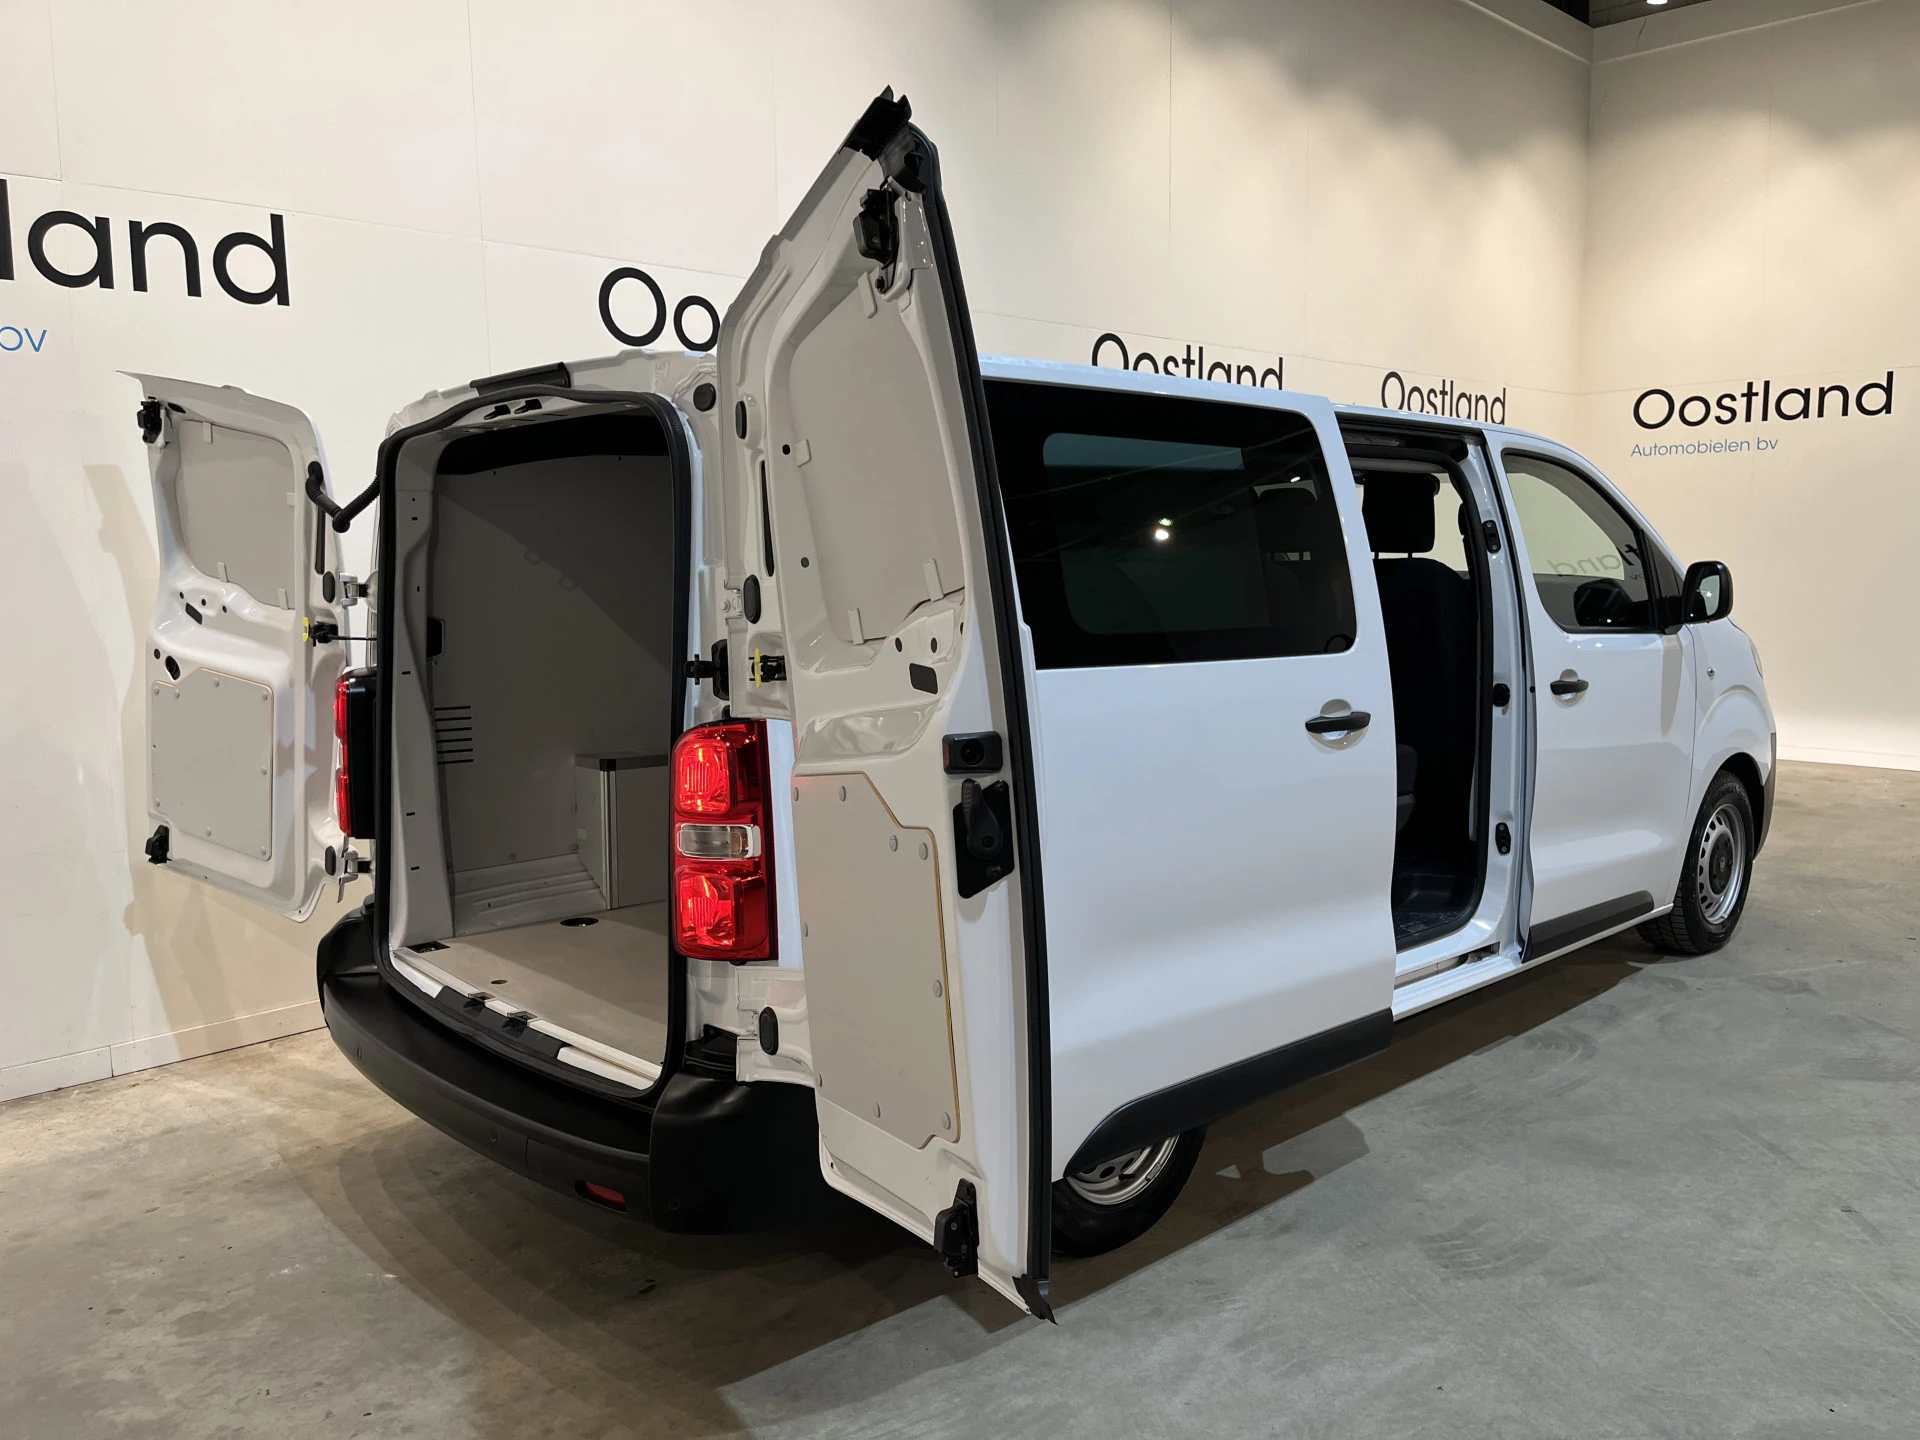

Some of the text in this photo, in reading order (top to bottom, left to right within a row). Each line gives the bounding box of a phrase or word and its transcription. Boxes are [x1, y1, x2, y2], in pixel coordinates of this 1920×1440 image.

[1381, 371, 1506, 425] Oostland
[1633, 371, 1894, 430] Oostland
[1630, 436, 1779, 457] Automobielen bv
